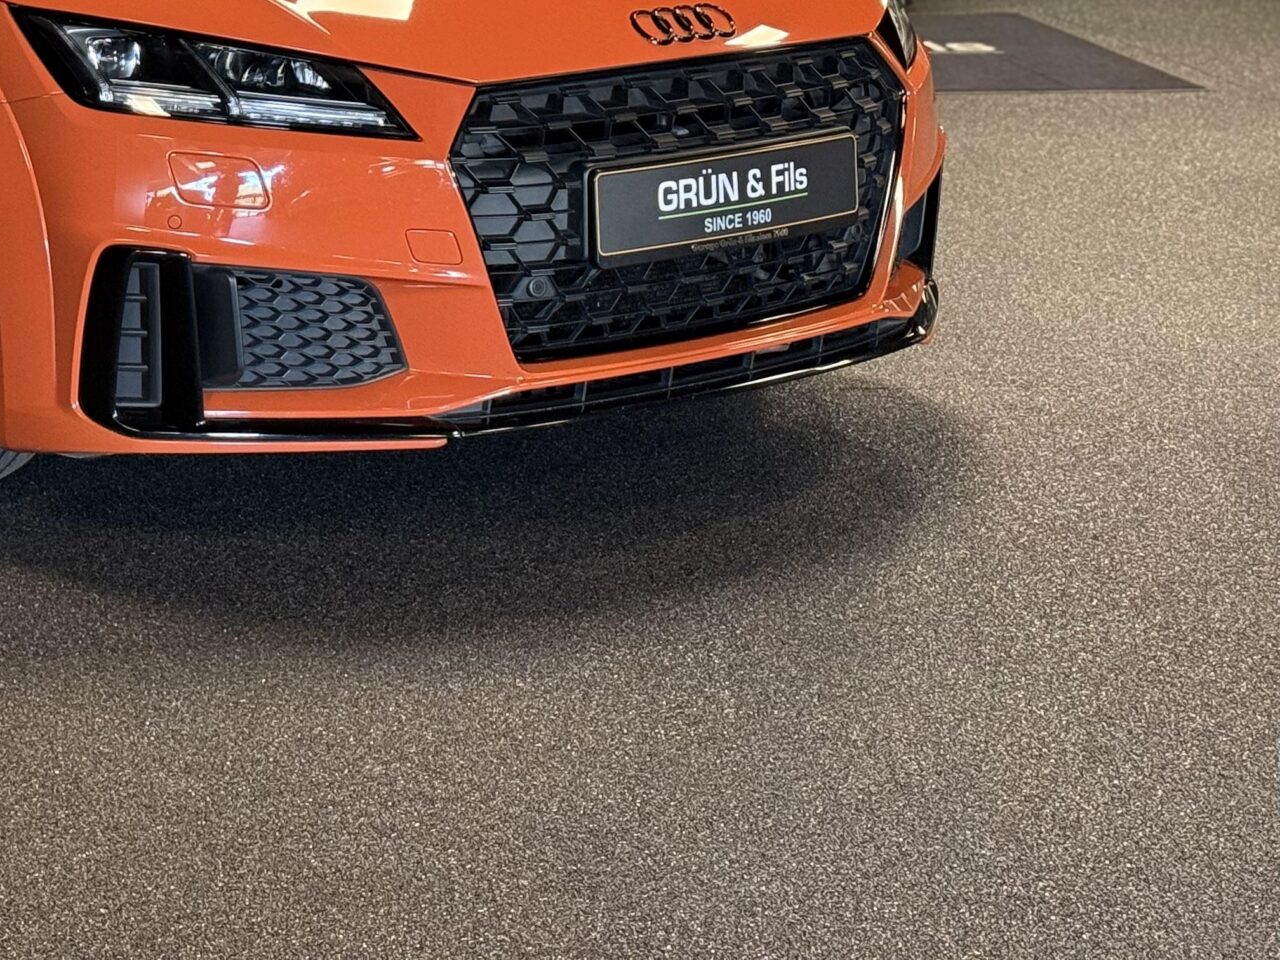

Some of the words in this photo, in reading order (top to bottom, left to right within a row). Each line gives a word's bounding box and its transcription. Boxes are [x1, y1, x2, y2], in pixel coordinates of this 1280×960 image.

[657, 168, 739, 212] GRÜN
[746, 168, 765, 198] &
[770, 161, 808, 195] Fils
[704, 213, 743, 233] SINCE
[746, 208, 772, 226] 1960
